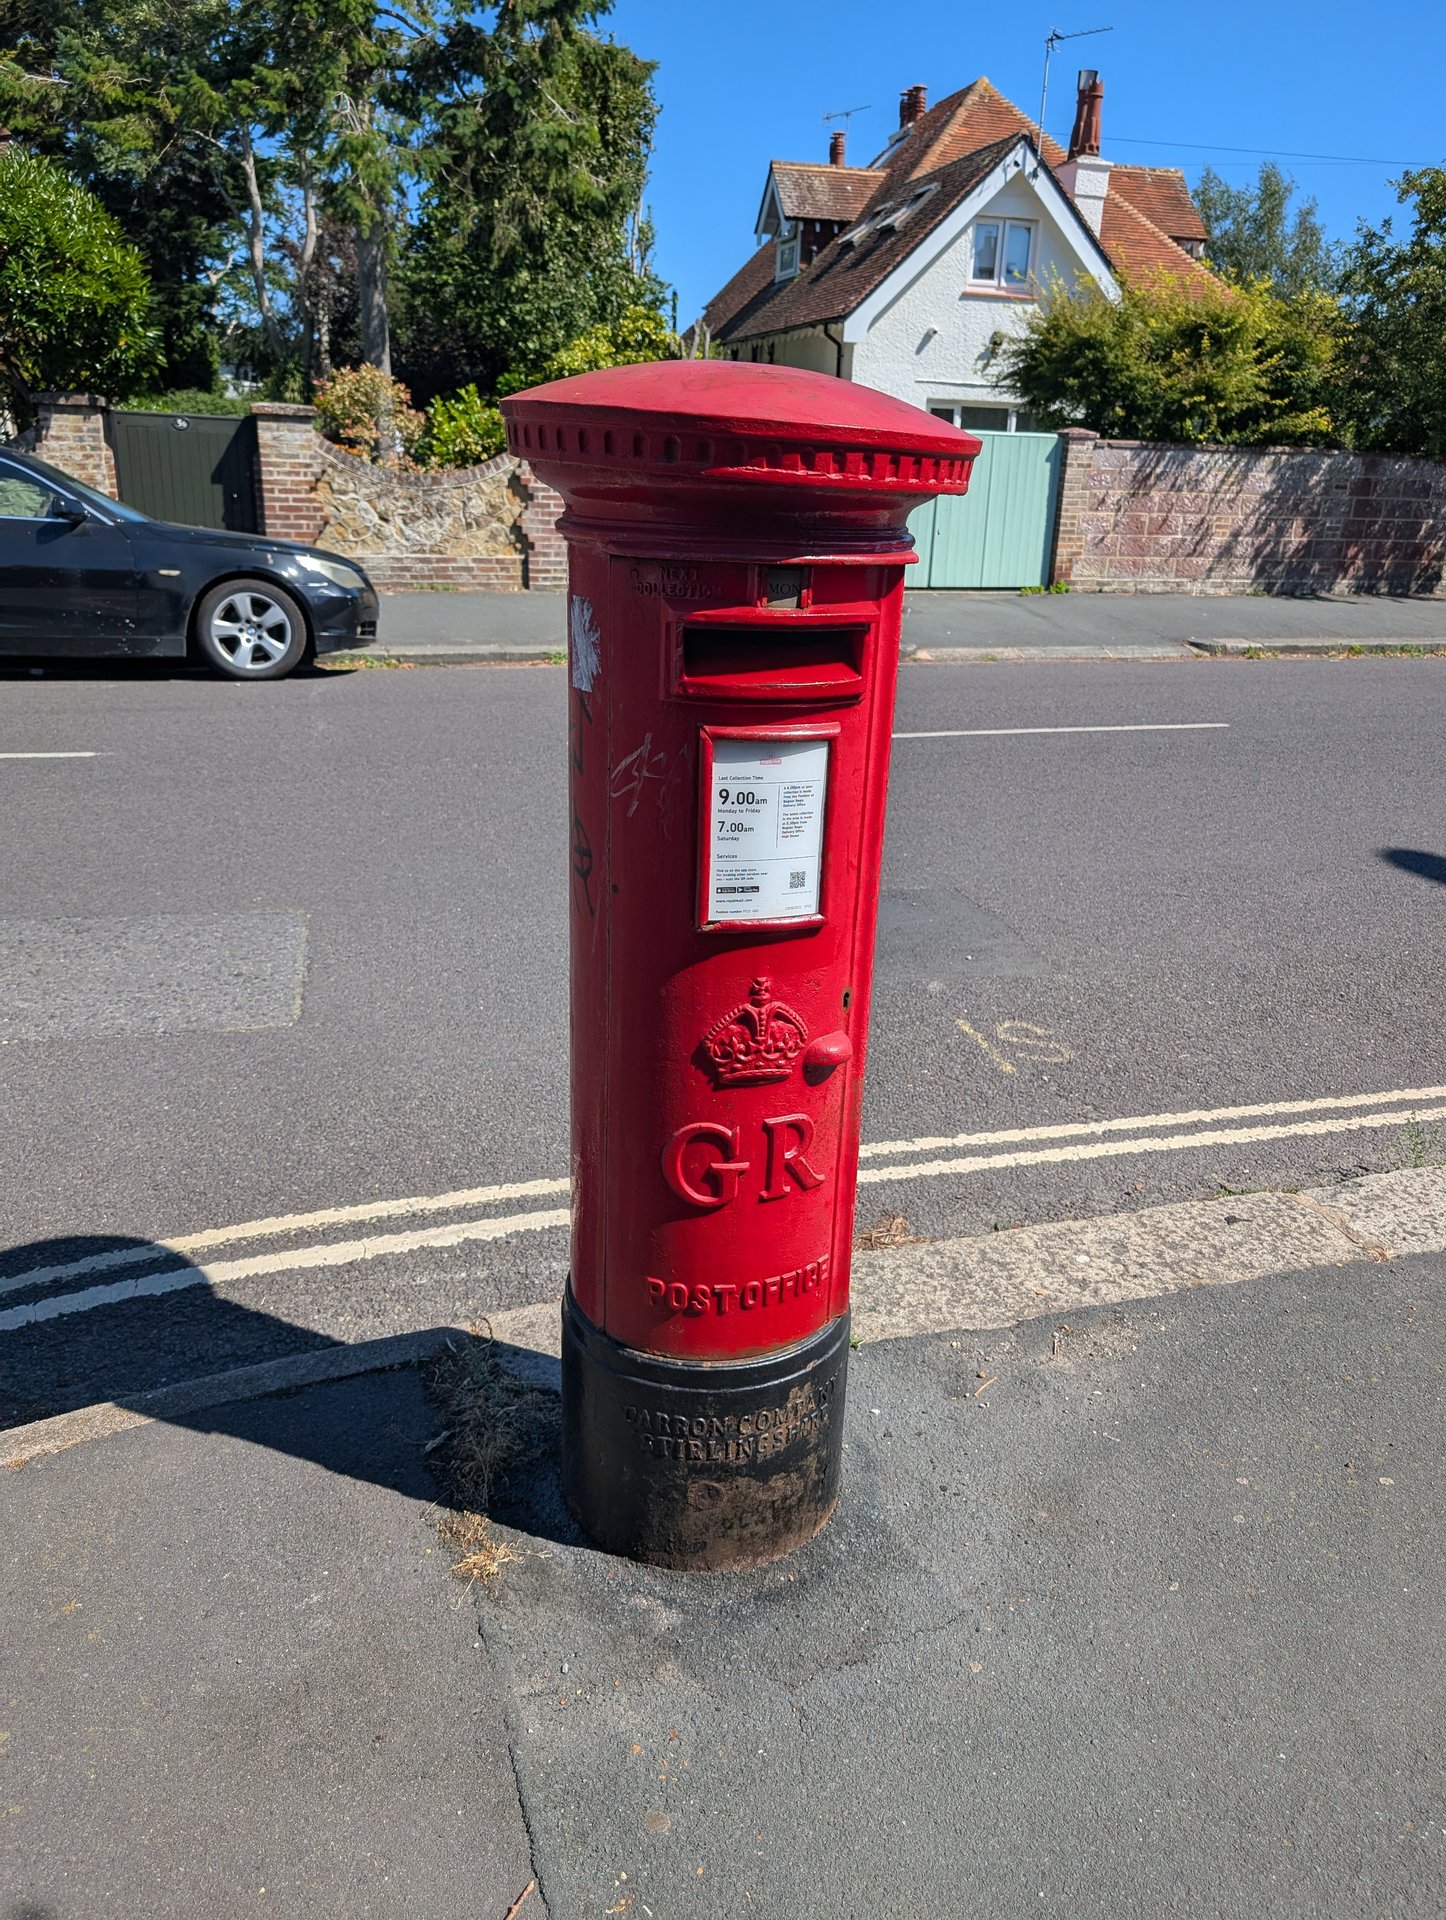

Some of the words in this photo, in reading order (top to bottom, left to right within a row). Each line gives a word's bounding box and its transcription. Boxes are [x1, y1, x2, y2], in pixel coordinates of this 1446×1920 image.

[660, 566, 699, 581] NEXT
[633, 581, 723, 599] COLLECTION
[768, 583, 801, 595] MON
[718, 788, 768, 805] 9.00am
[717, 820, 754, 832] 7.00am
[661, 1113, 825, 1210] GR
[647, 1276, 736, 1315] POST
[739, 1253, 830, 1311] OFFICE
[623, 1406, 730, 1439] CARRON
[737, 1374, 839, 1436] COMPANY
[641, 1403, 829, 1462] STIRLINGSHIRE
